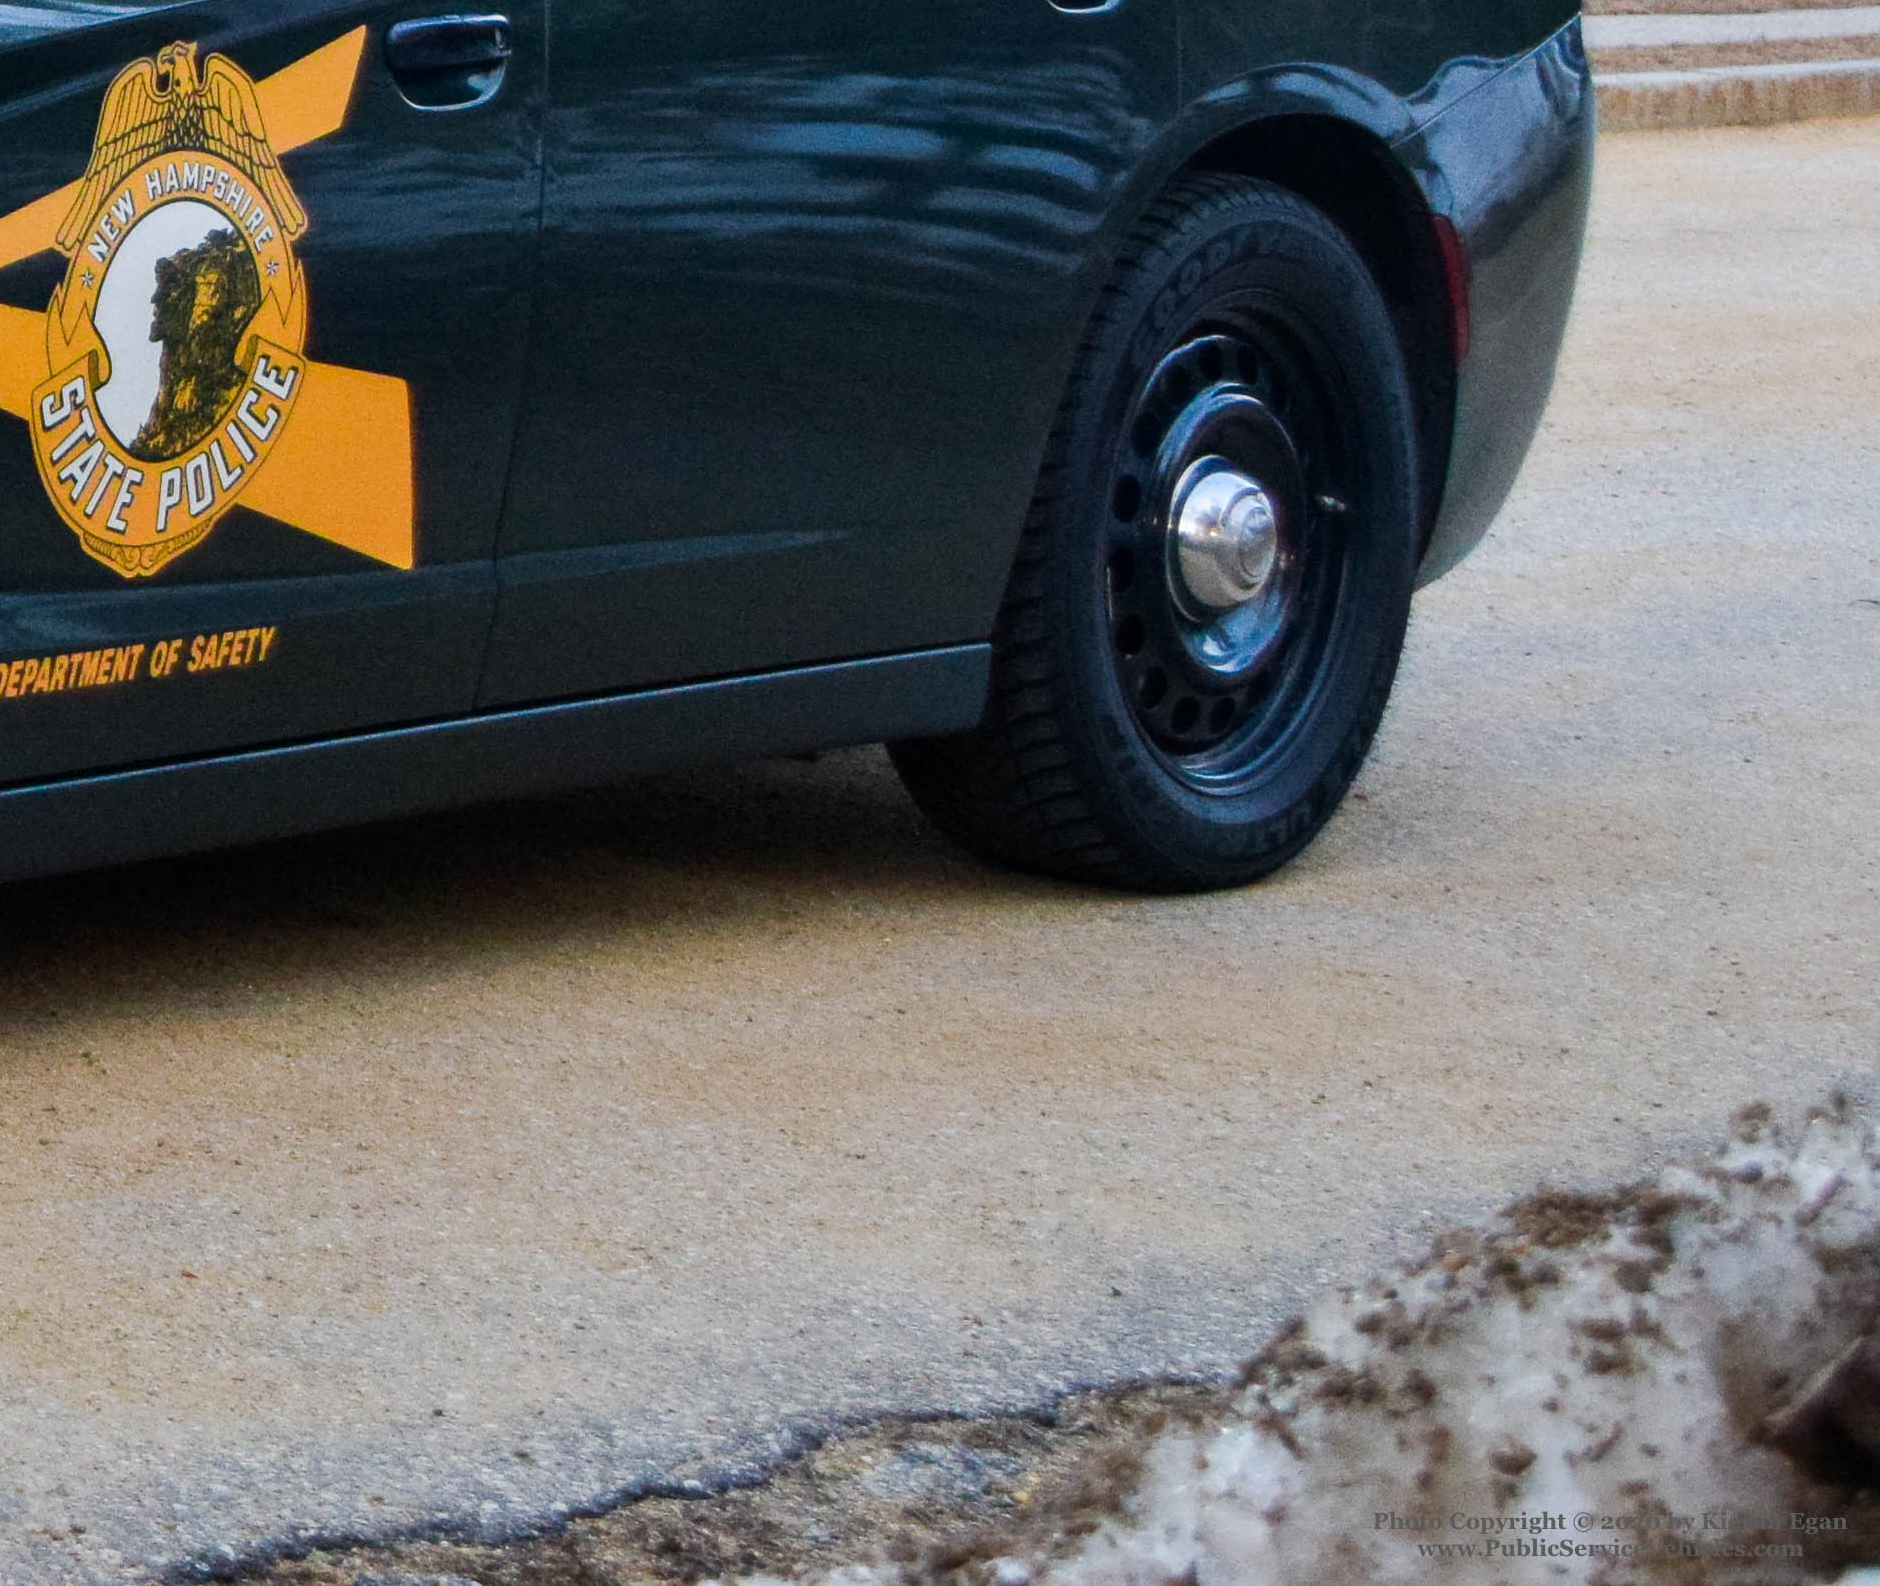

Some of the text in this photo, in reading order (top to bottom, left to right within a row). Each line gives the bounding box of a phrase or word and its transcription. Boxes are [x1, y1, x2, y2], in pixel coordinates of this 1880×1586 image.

[87, 162, 275, 264] NEW HAMPSHIRE
[40, 353, 298, 535] STATE POLICE
[150, 638, 182, 677] OF
[187, 626, 278, 673] SAFETY
